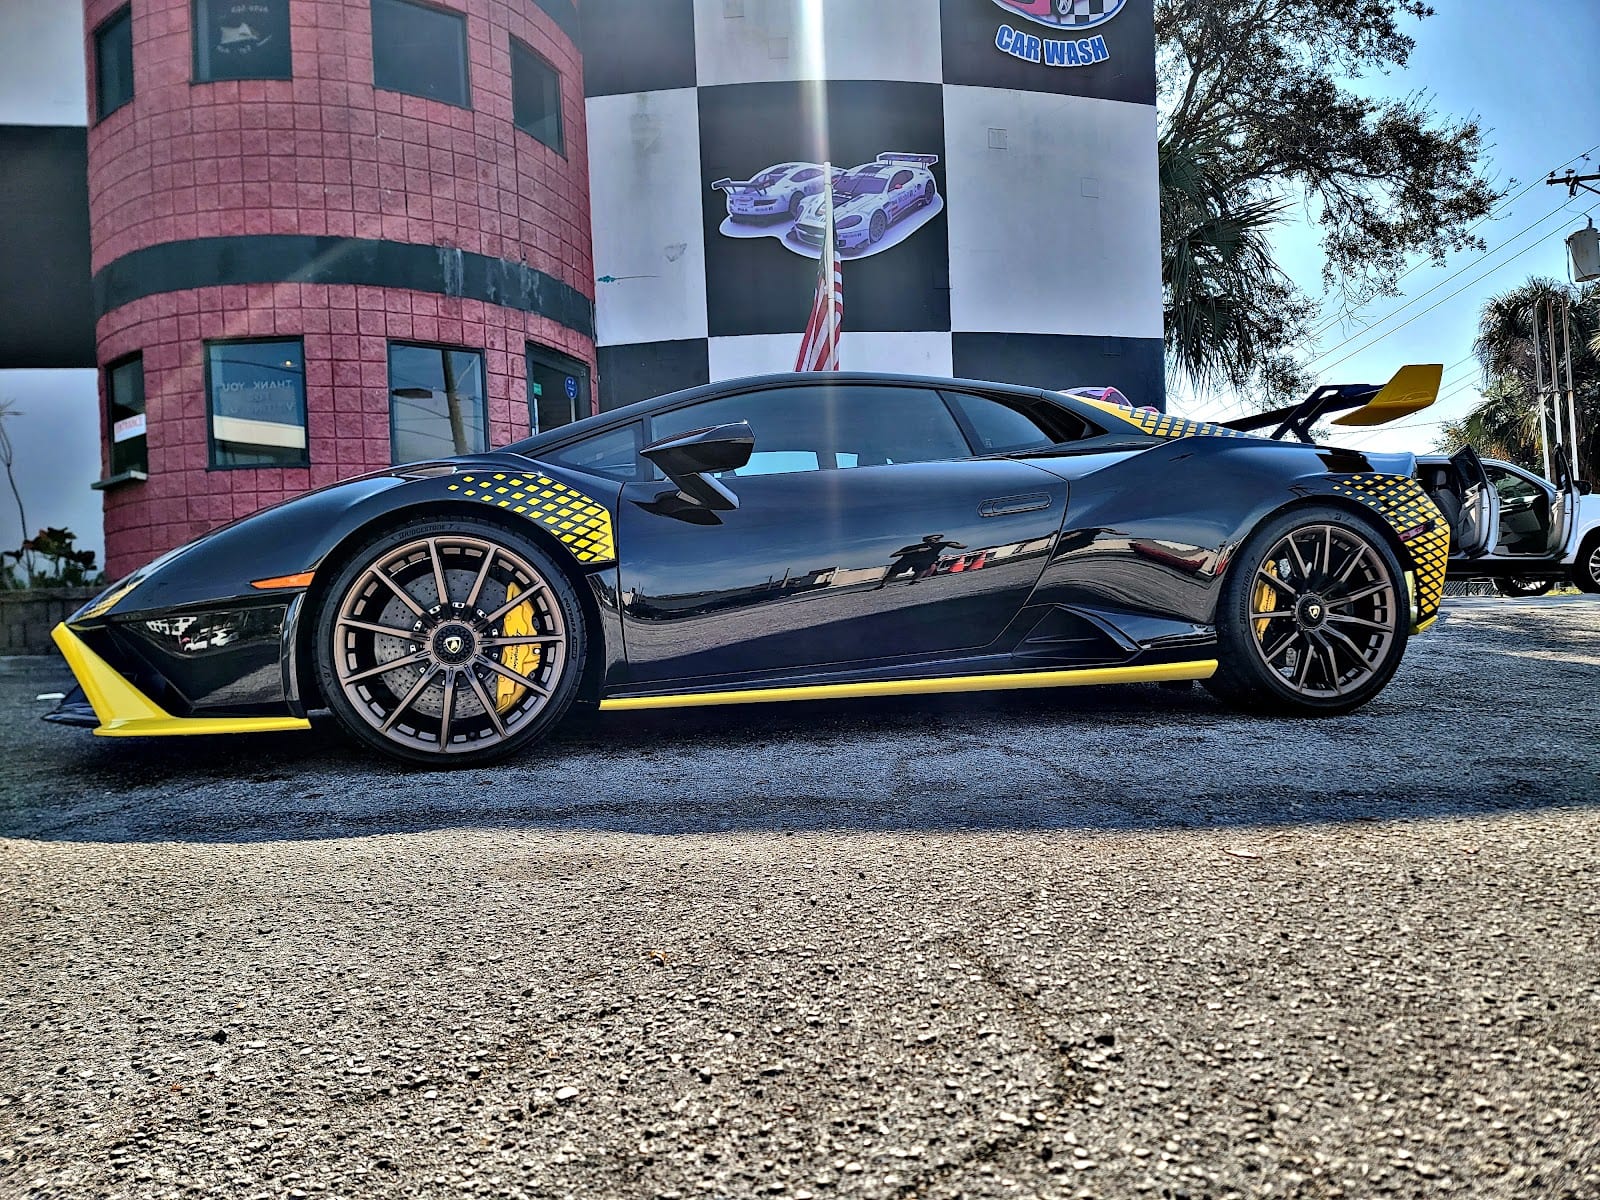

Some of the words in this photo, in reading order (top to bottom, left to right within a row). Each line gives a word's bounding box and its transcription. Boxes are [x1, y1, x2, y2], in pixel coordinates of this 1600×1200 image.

[995, 24, 1041, 63] CAR
[1043, 34, 1110, 67] WASH
[563, 597, 577, 633] POTENZA
